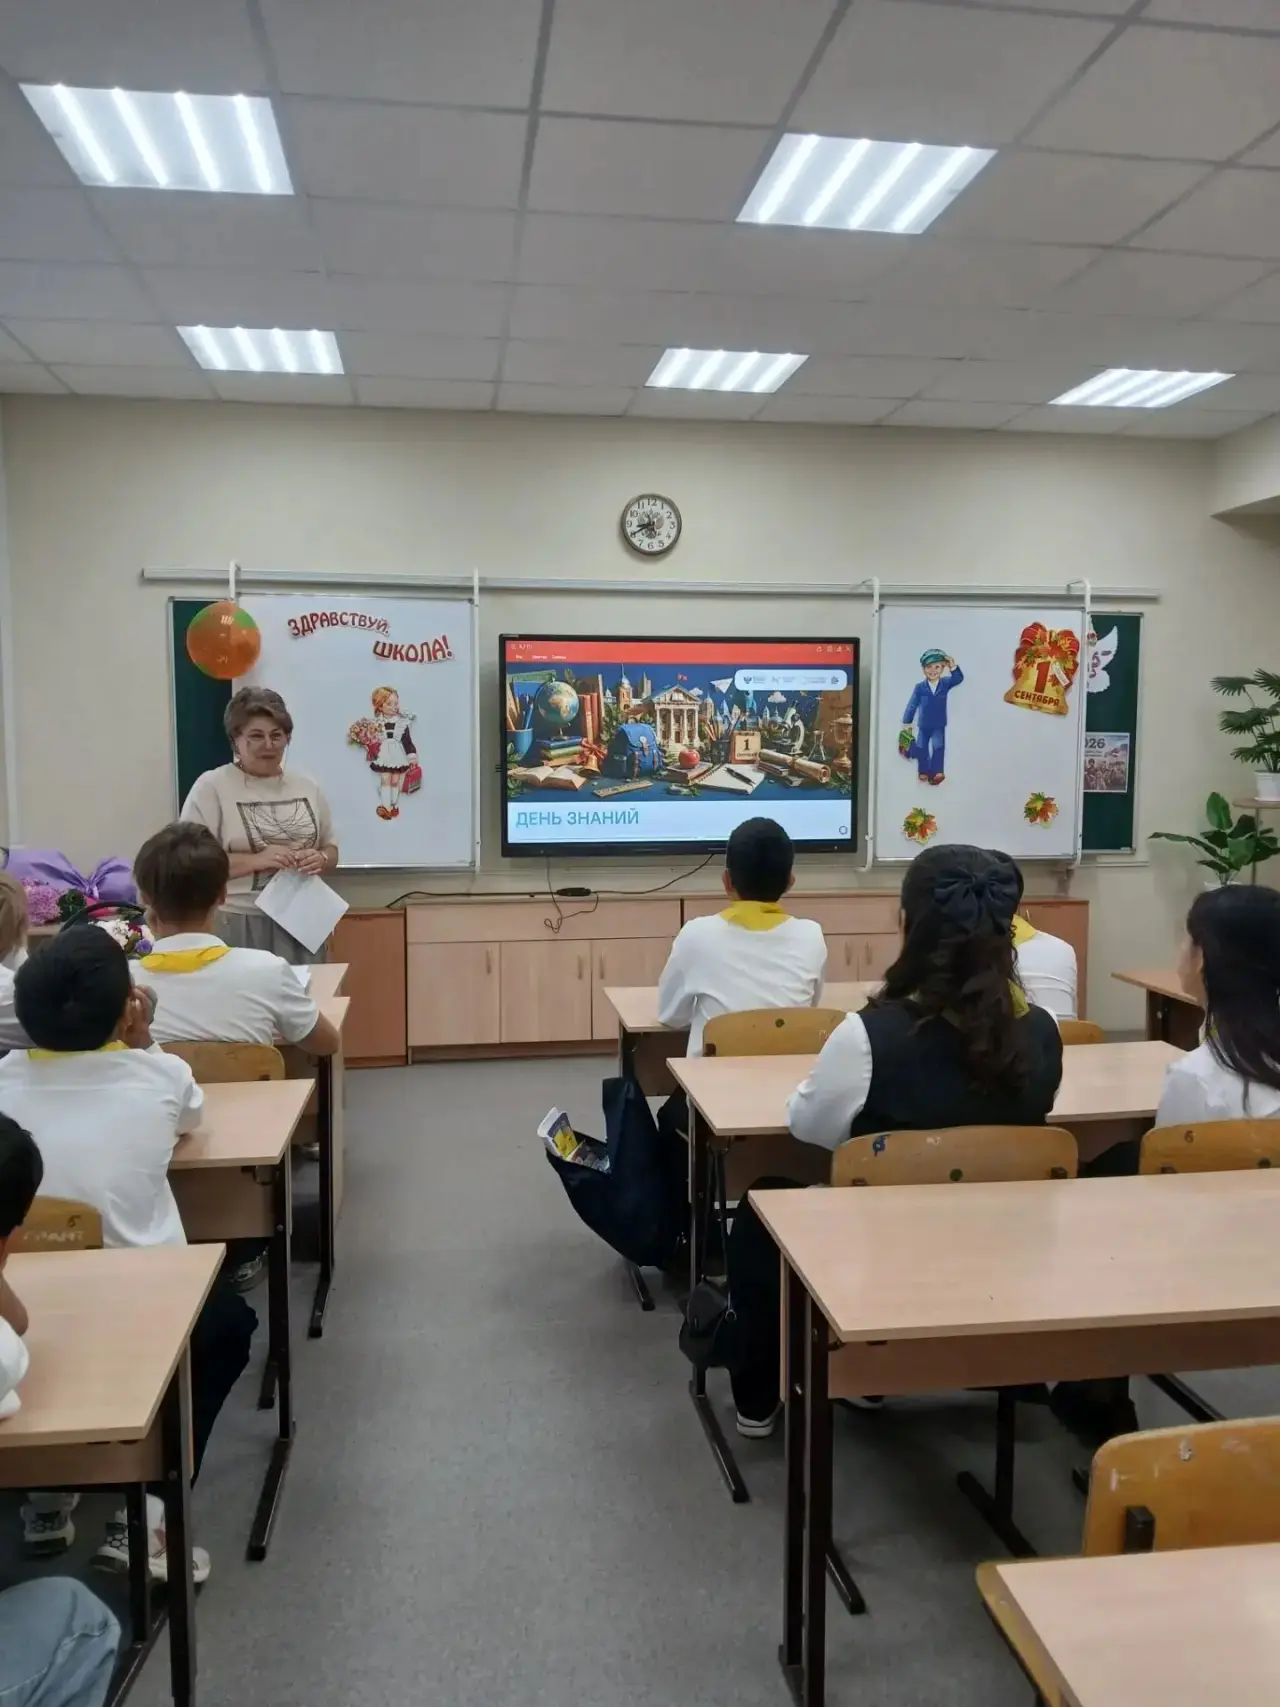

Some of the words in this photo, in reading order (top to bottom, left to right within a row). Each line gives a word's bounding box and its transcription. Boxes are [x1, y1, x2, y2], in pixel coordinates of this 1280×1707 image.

[637, 501, 645, 509] 11
[647, 498, 657, 506] 12
[630, 510, 638, 518] 10
[666, 511, 672, 519] 2
[670, 521, 675, 529] 3
[638, 539, 644, 548] 7
[658, 540, 664, 548] 5
[373, 635, 453, 662] ШКОЛА!
[1034, 661, 1051, 694] 1
[1014, 690, 1060, 706] СЕНТЯБРЯ
[743, 738, 750, 751] 1
[516, 811, 562, 828] ДЕНЬ
[566, 807, 639, 826] ЗНАНИЙ
